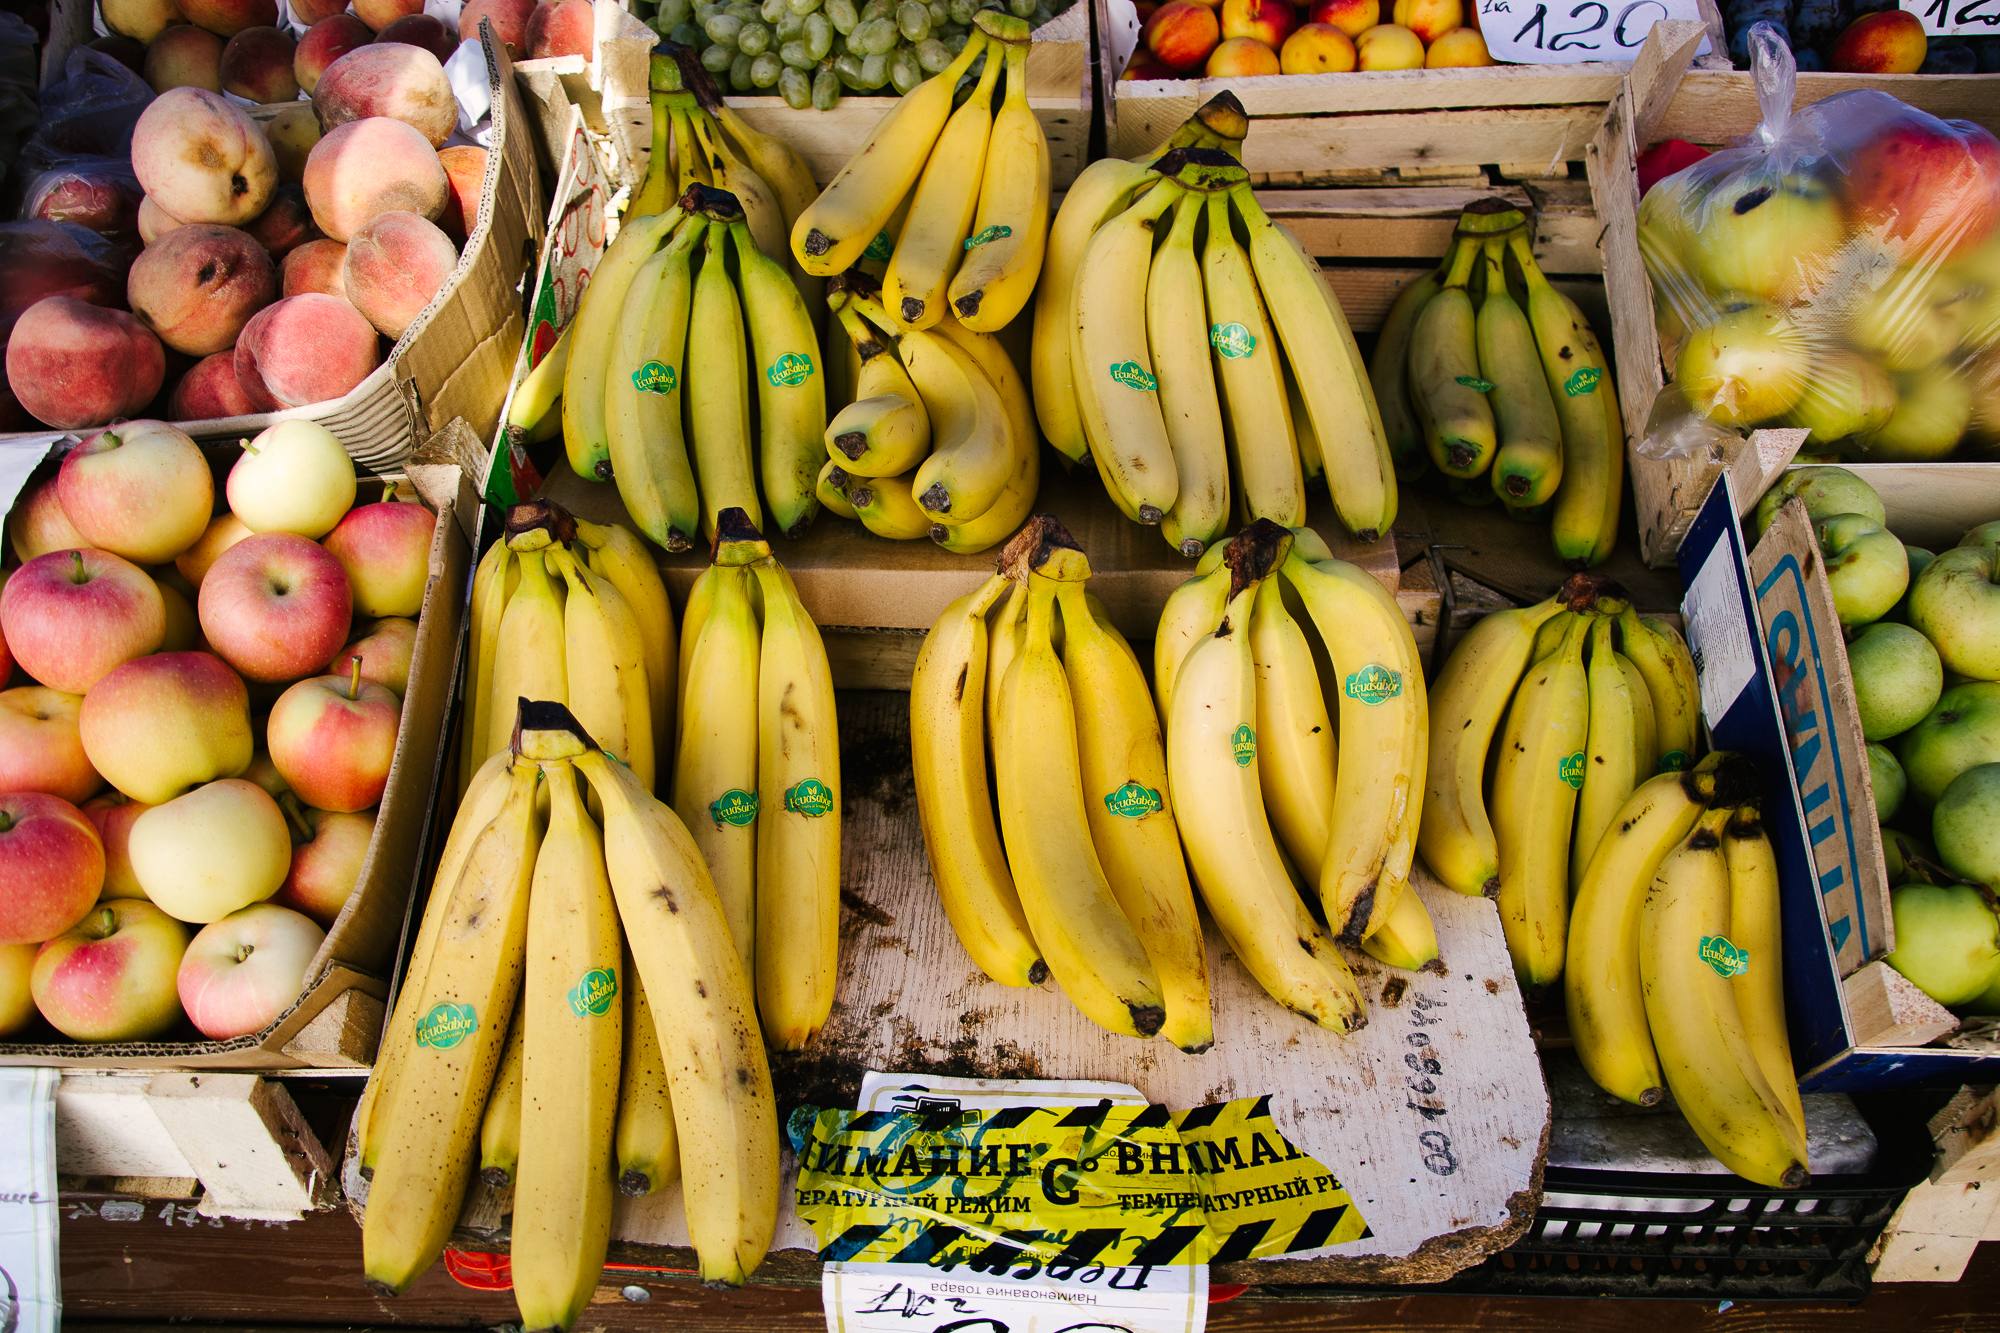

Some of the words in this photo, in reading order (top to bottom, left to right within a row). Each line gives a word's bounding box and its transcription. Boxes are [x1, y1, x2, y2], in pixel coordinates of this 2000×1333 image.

[1513, 1, 1668, 51] 120
[636, 374, 674, 388] Ecuasabor
[771, 363, 810, 383] Ecuasabor
[1114, 370, 1155, 388] Ecuasabor
[1569, 373, 1599, 395] Ecuasab
[1350, 680, 1399, 694] Ecuasabor
[790, 792, 832, 809] Ecuasabor
[1109, 793, 1157, 812] Ecuasabor
[1702, 945, 1746, 969] Ecuasabor
[575, 982, 614, 1013] Ecuasabor
[419, 1018, 472, 1043] Ecuasabor
[795, 1189, 938, 1212] ЕРАТУРНЫЙ
[944, 1195, 1032, 1214] РЕЖИМ
[1117, 1176, 1312, 1214] ТЕМПЕАТУРНЫЙ
[930, 1282, 981, 1297] товара
[985, 1287, 1097, 1305] Наименование
